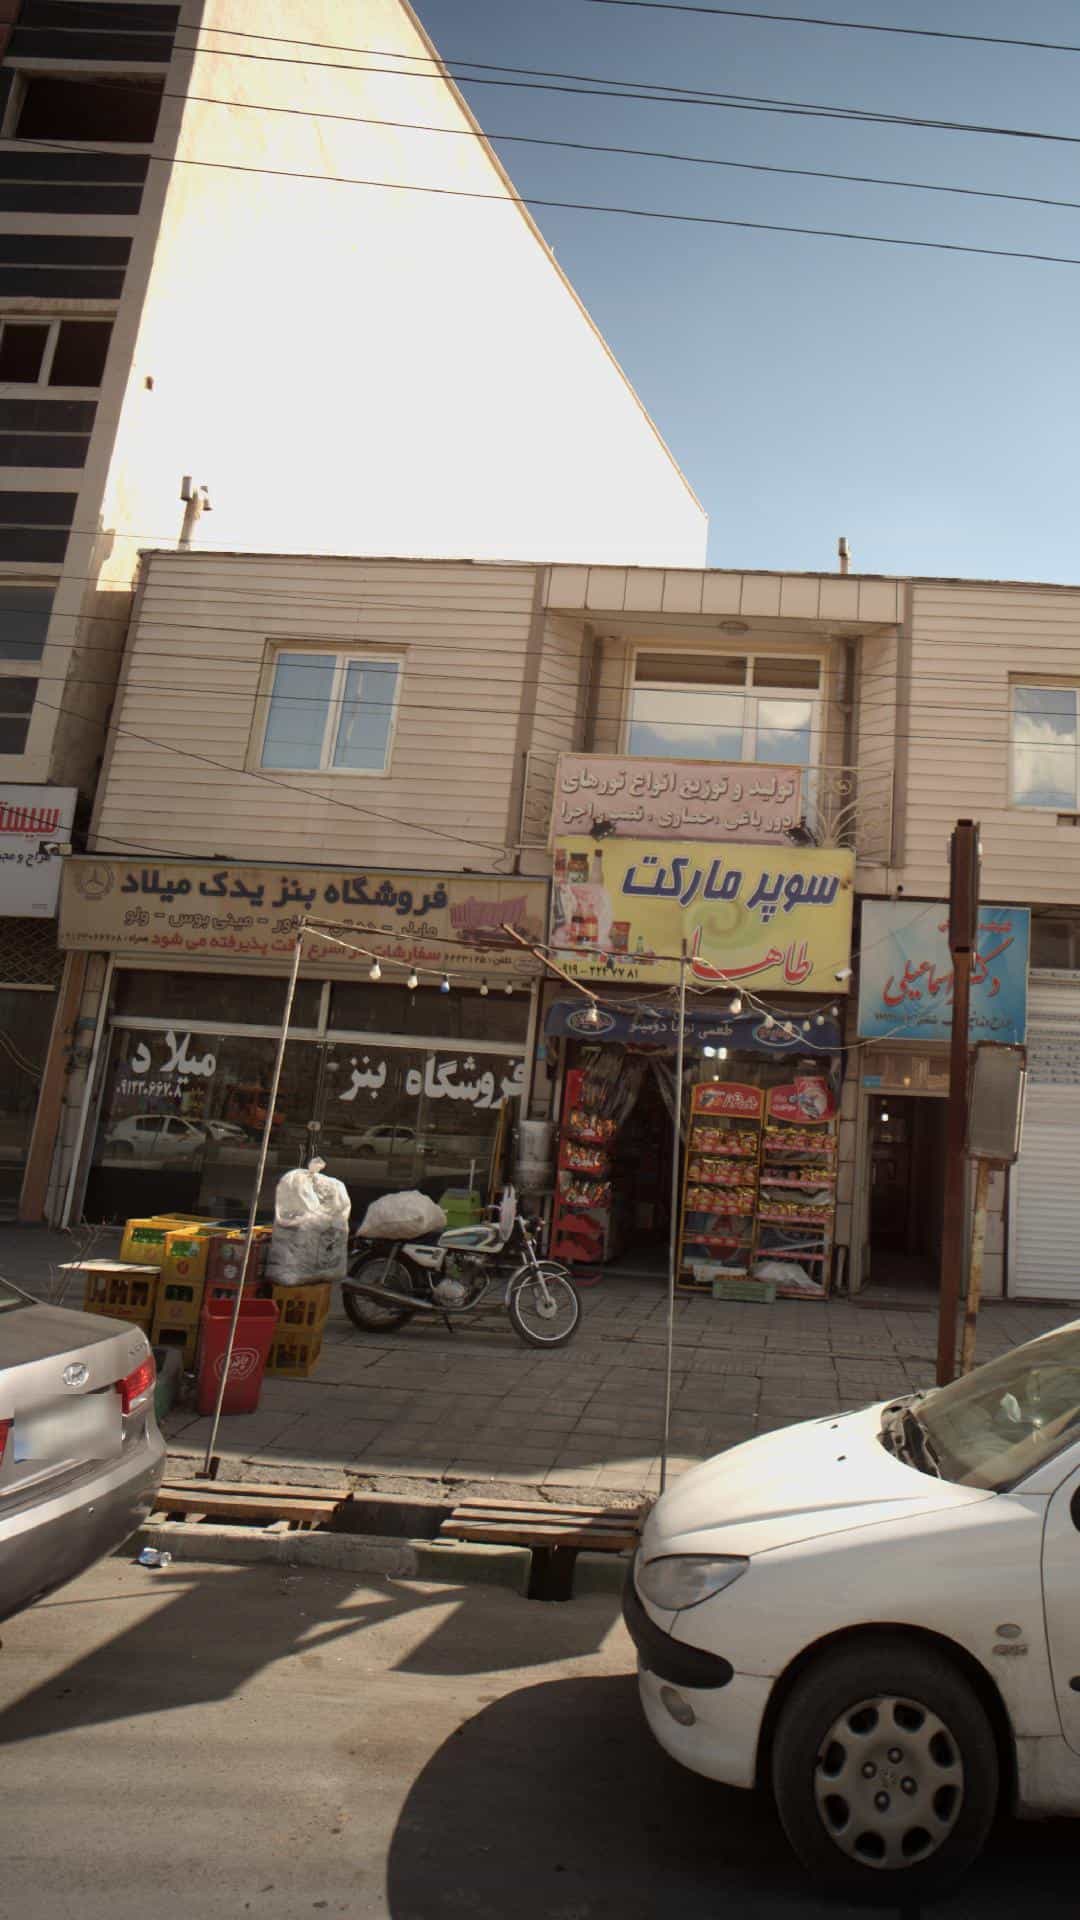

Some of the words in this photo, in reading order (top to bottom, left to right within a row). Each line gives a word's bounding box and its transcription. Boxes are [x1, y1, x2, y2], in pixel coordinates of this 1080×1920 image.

[560, 768, 626, 798] تورهای
[628, 770, 677, 800] انواع
[679, 776, 728, 800] توزیع
[732, 783, 743, 800] و
[750, 776, 794, 804] تولید
[560, 800, 594, 823] اجرا
[120, 868, 191, 903] میلاد
[199, 871, 265, 907] یدک
[271, 876, 317, 911] بنز
[323, 874, 449, 917] فروشگاه
[621, 854, 744, 909] مارکت
[746, 870, 842, 924] سوپر
[212, 911, 254, 931] مینی
[151, 931, 184, 949] شود
[209, 935, 269, 956] پذیرفته
[373, 944, 442, 962] سفارشات
[689, 925, 814, 984] طاها
[339, 1056, 388, 1101] بنز
[405, 1055, 528, 1109] فروشگاه
